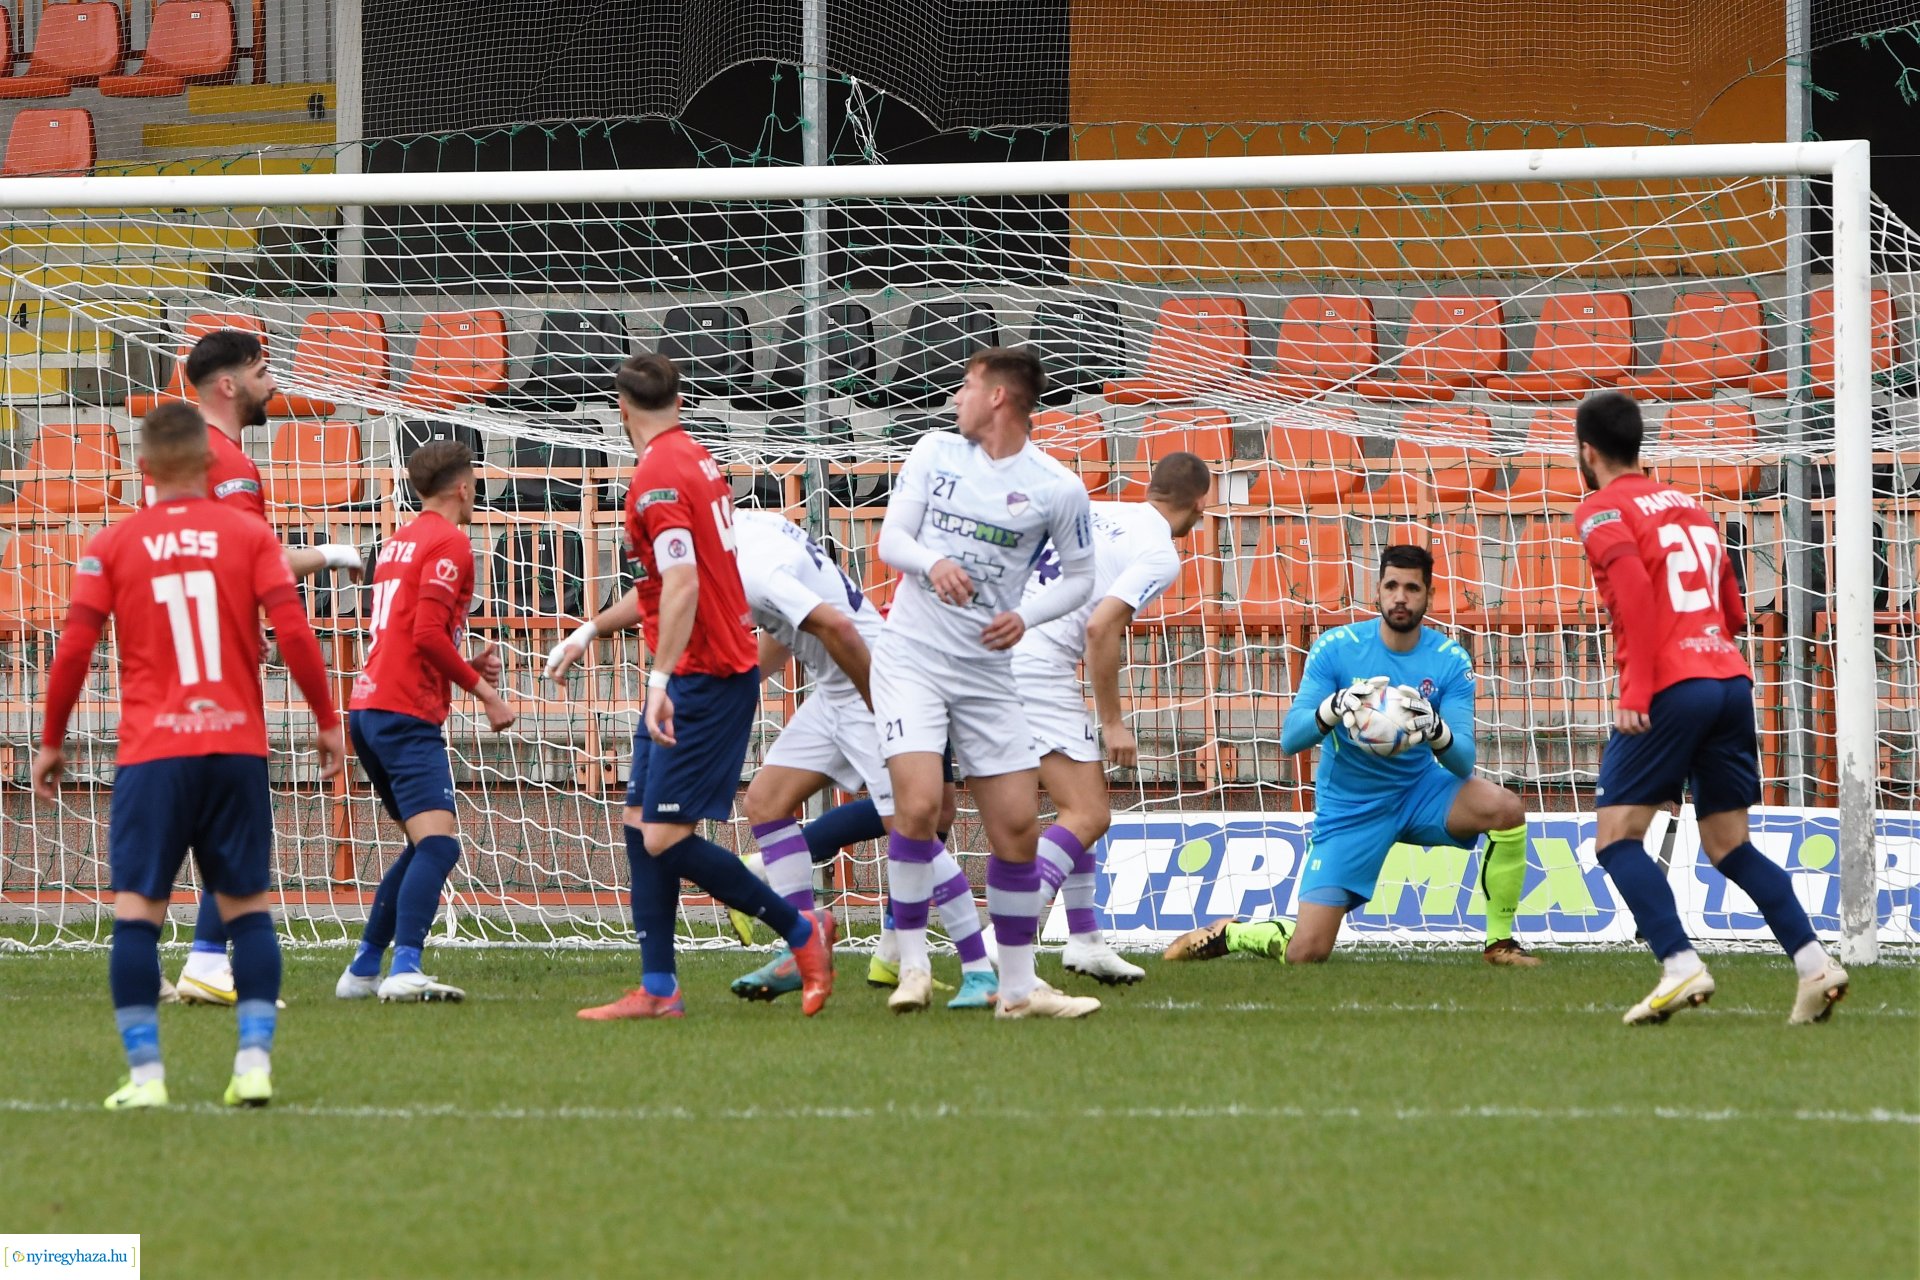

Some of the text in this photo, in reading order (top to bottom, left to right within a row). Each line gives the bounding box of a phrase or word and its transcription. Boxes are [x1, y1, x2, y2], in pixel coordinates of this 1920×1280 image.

[13, 302, 29, 328] 4
[933, 477, 956, 500] 21
[142, 529, 218, 561] VASS
[1657, 523, 1722, 613] 20
[151, 570, 222, 686] 11
[885, 718, 904, 742] 21
[1084, 724, 1094, 742] 4
